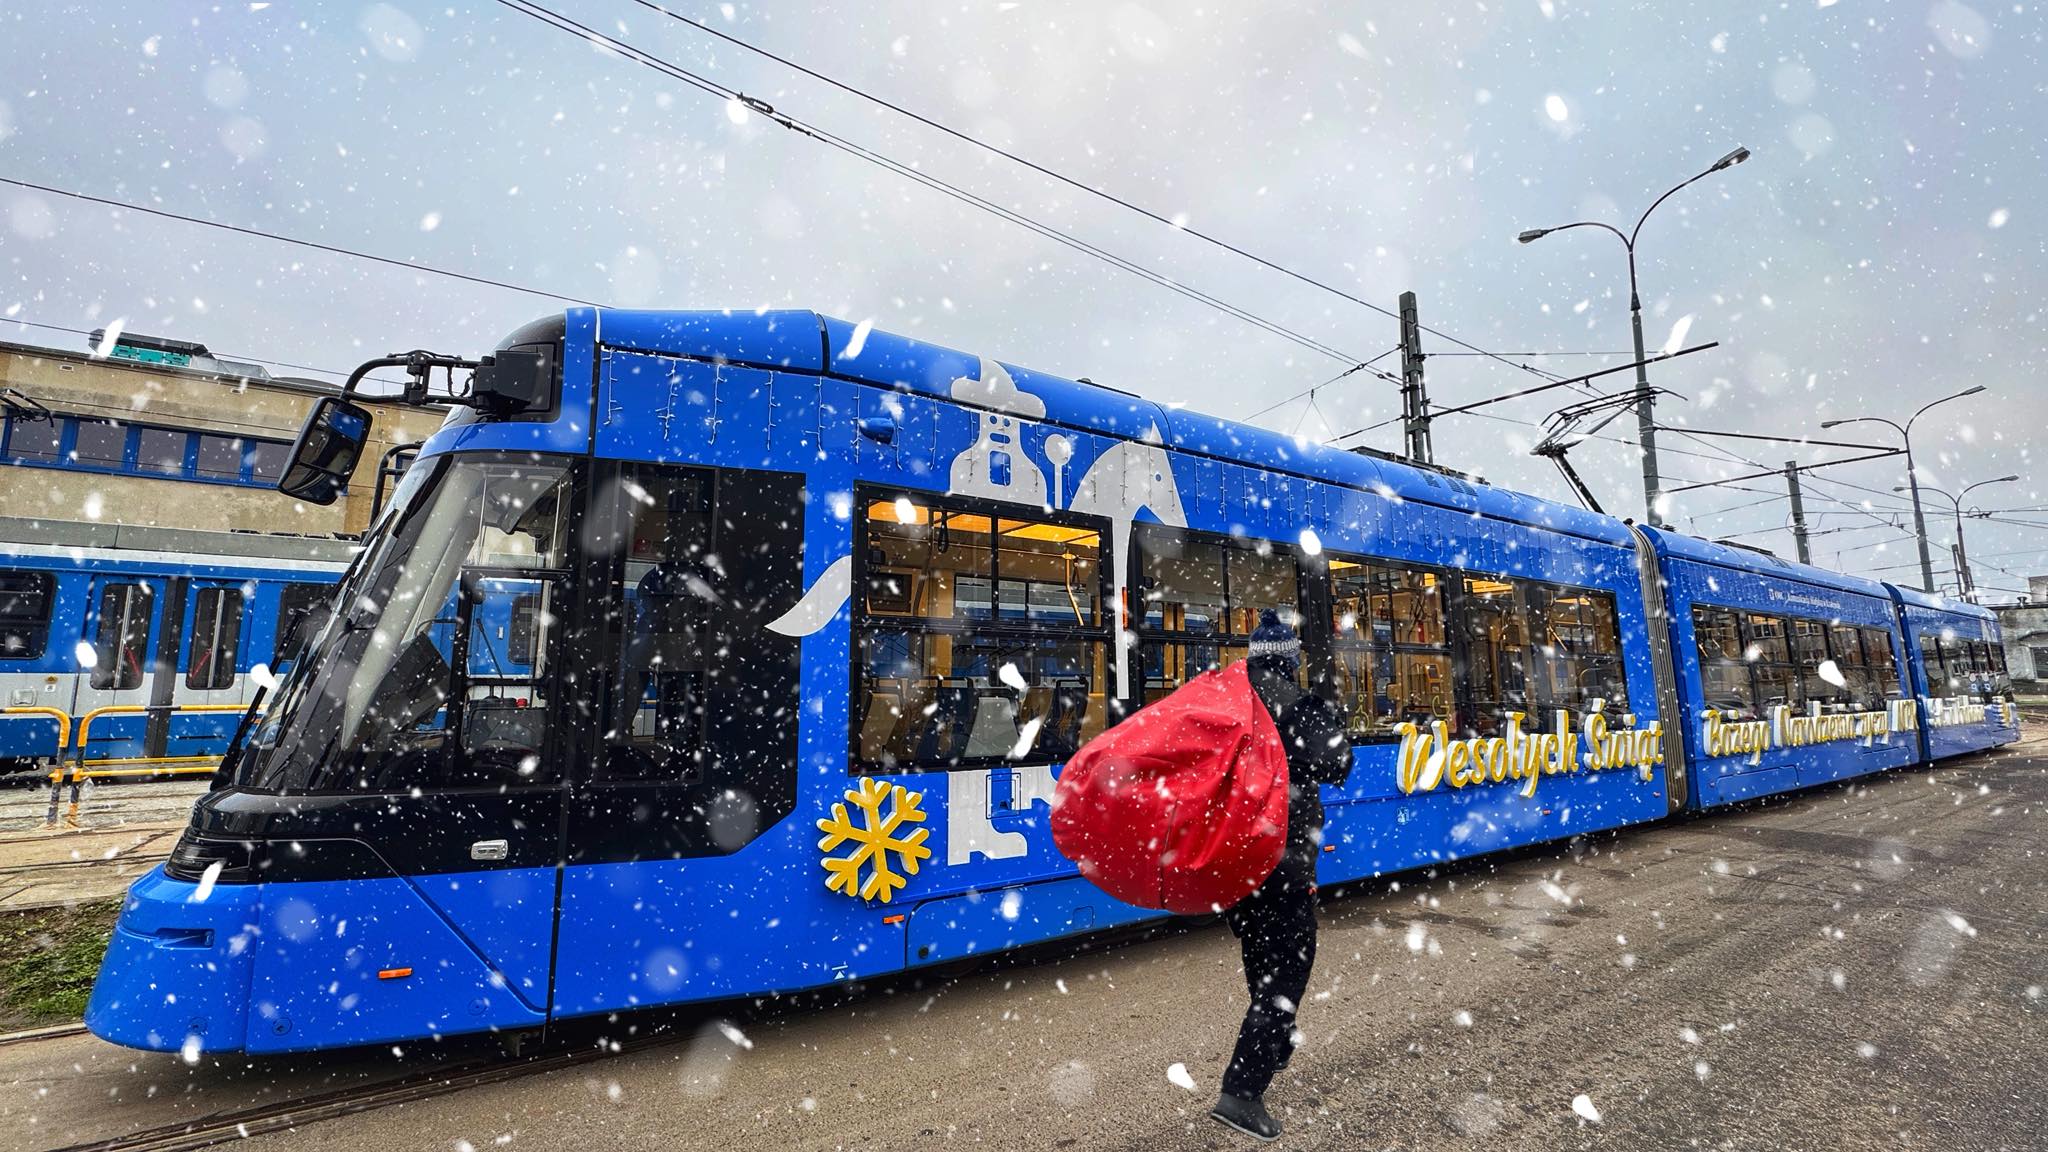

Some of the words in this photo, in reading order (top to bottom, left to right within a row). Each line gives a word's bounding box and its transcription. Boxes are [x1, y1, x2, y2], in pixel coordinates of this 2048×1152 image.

[1393, 709, 1579, 798] Wesołych
[1584, 697, 1663, 782] Świąt
[1701, 709, 1771, 767] Bożego
